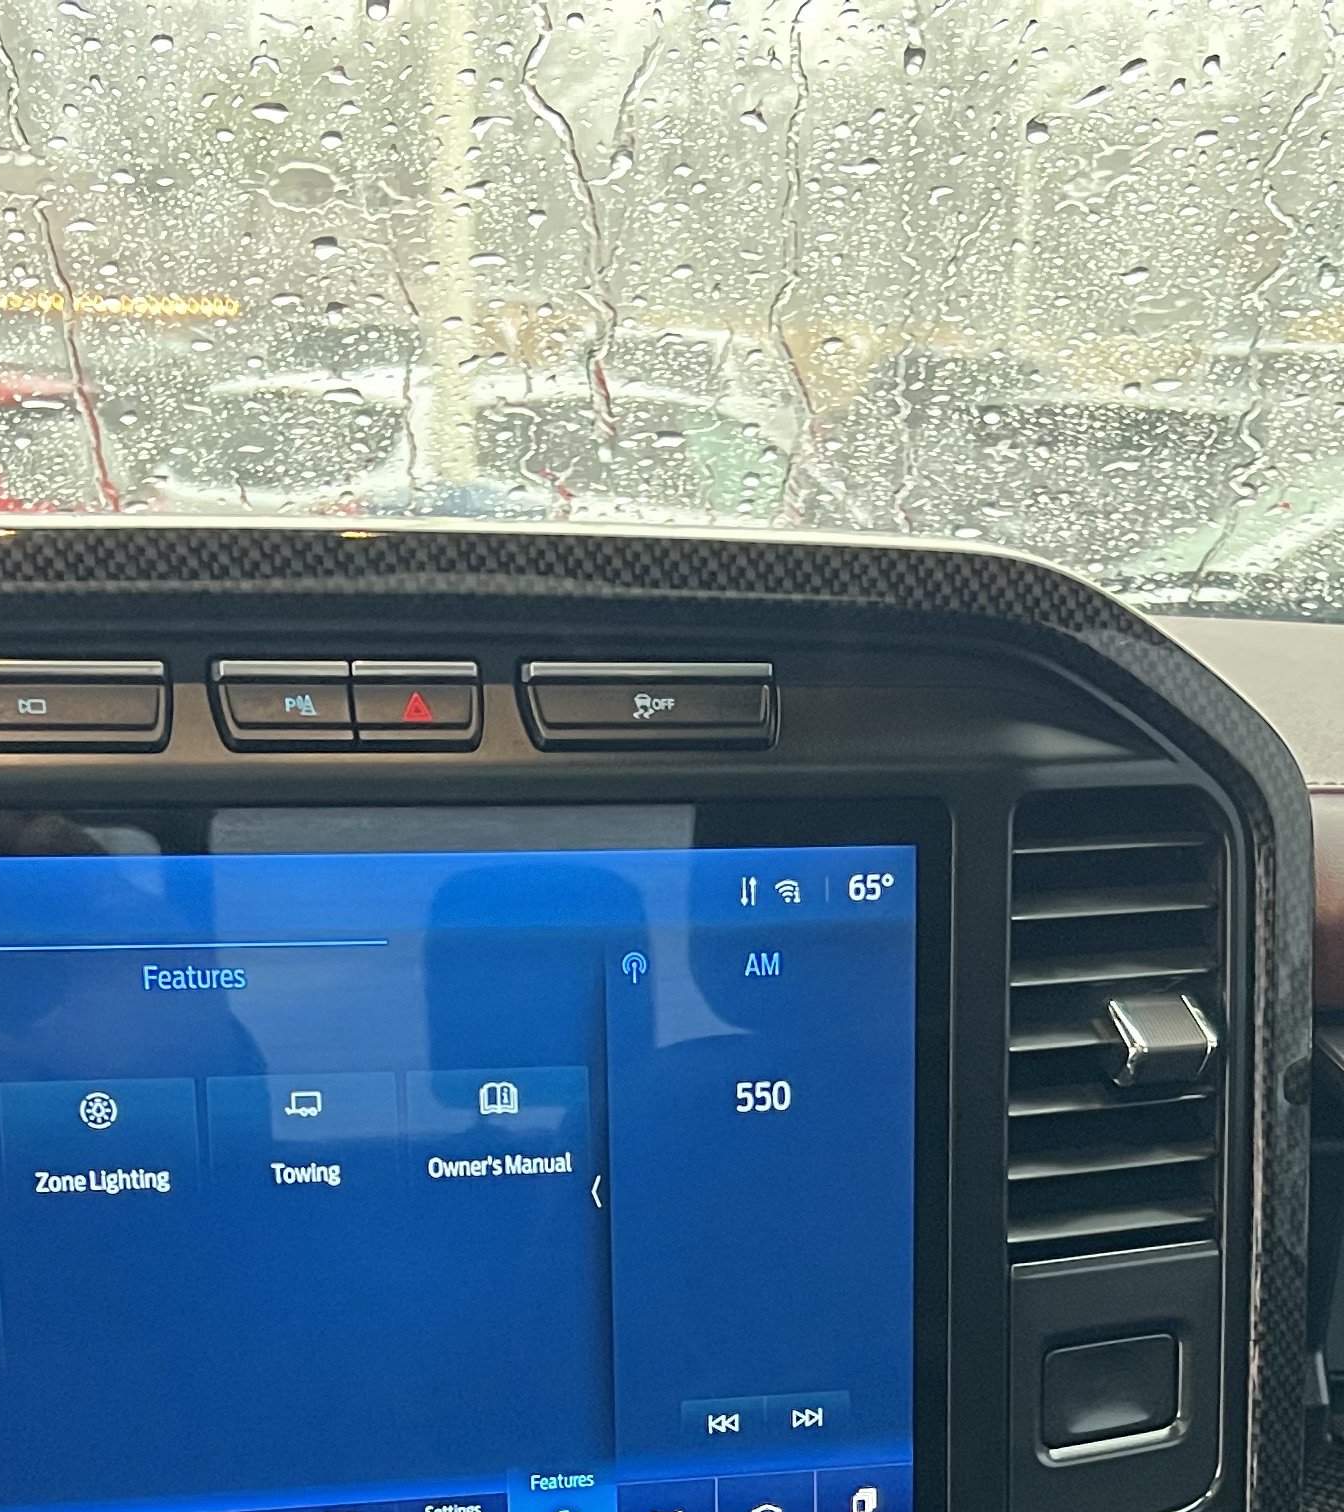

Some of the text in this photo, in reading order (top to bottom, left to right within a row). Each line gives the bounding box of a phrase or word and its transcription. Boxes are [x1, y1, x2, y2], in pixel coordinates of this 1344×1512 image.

[651, 698, 675, 712] OFF
[744, 952, 781, 977] AM
[143, 964, 247, 992] Features
[735, 1081, 791, 1112] 550
[271, 1162, 342, 1187] Towing
[428, 1152, 573, 1179] Owner's Manual
[35, 1169, 171, 1194] Zone Lighting
[530, 1472, 595, 1491] Features
